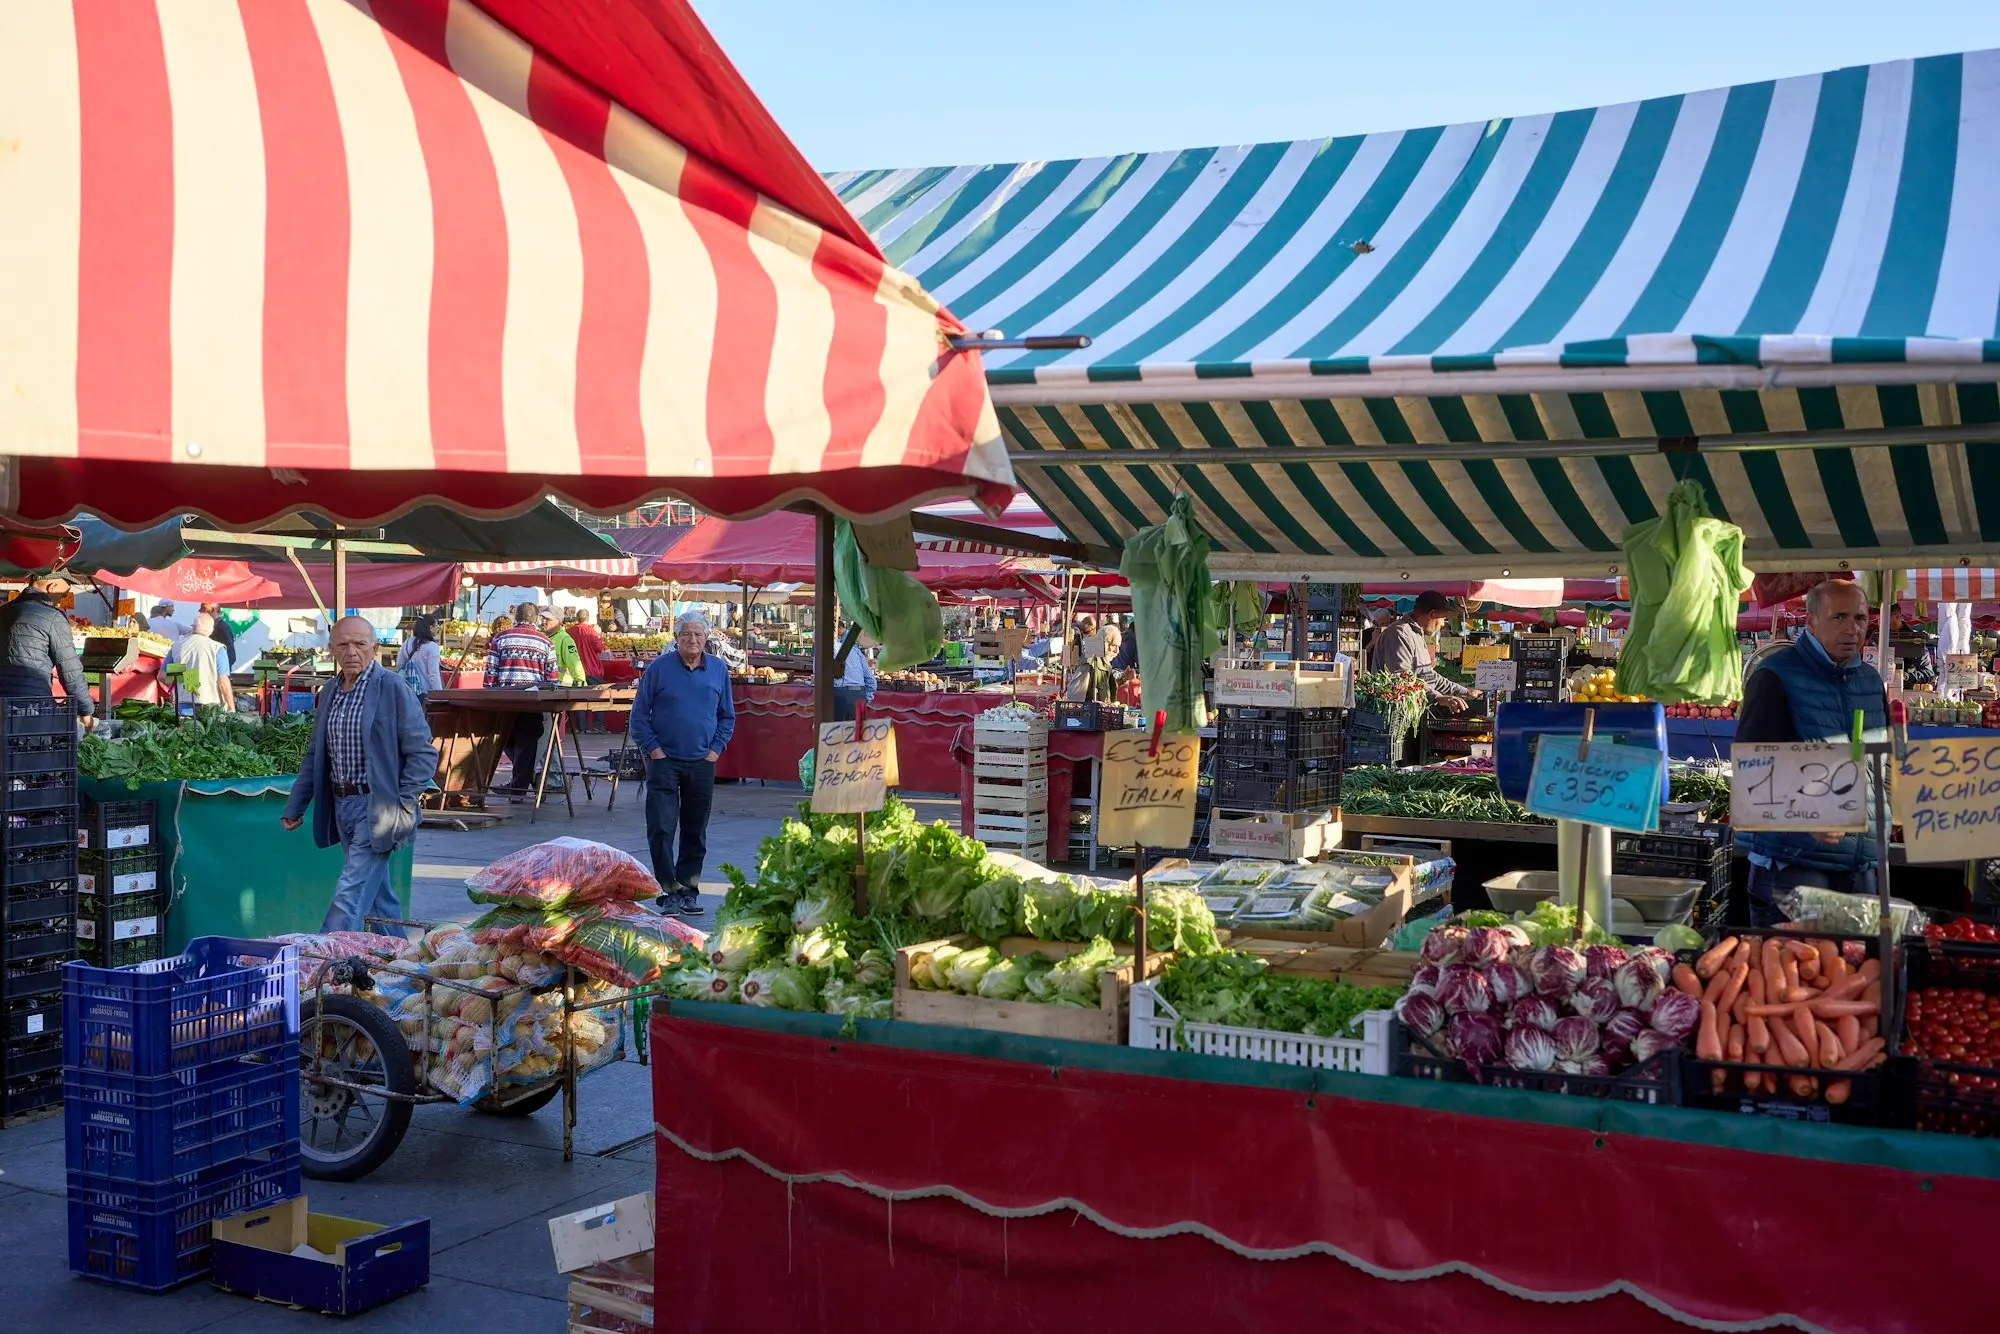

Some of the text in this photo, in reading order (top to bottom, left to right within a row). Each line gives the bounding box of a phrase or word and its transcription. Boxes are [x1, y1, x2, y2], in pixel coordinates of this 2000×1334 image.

[1754, 744, 1780, 753] ETTO
[1545, 782, 1557, 796] €
[1837, 799, 1858, 811] €
[1762, 810, 1821, 820] AL CHILO
